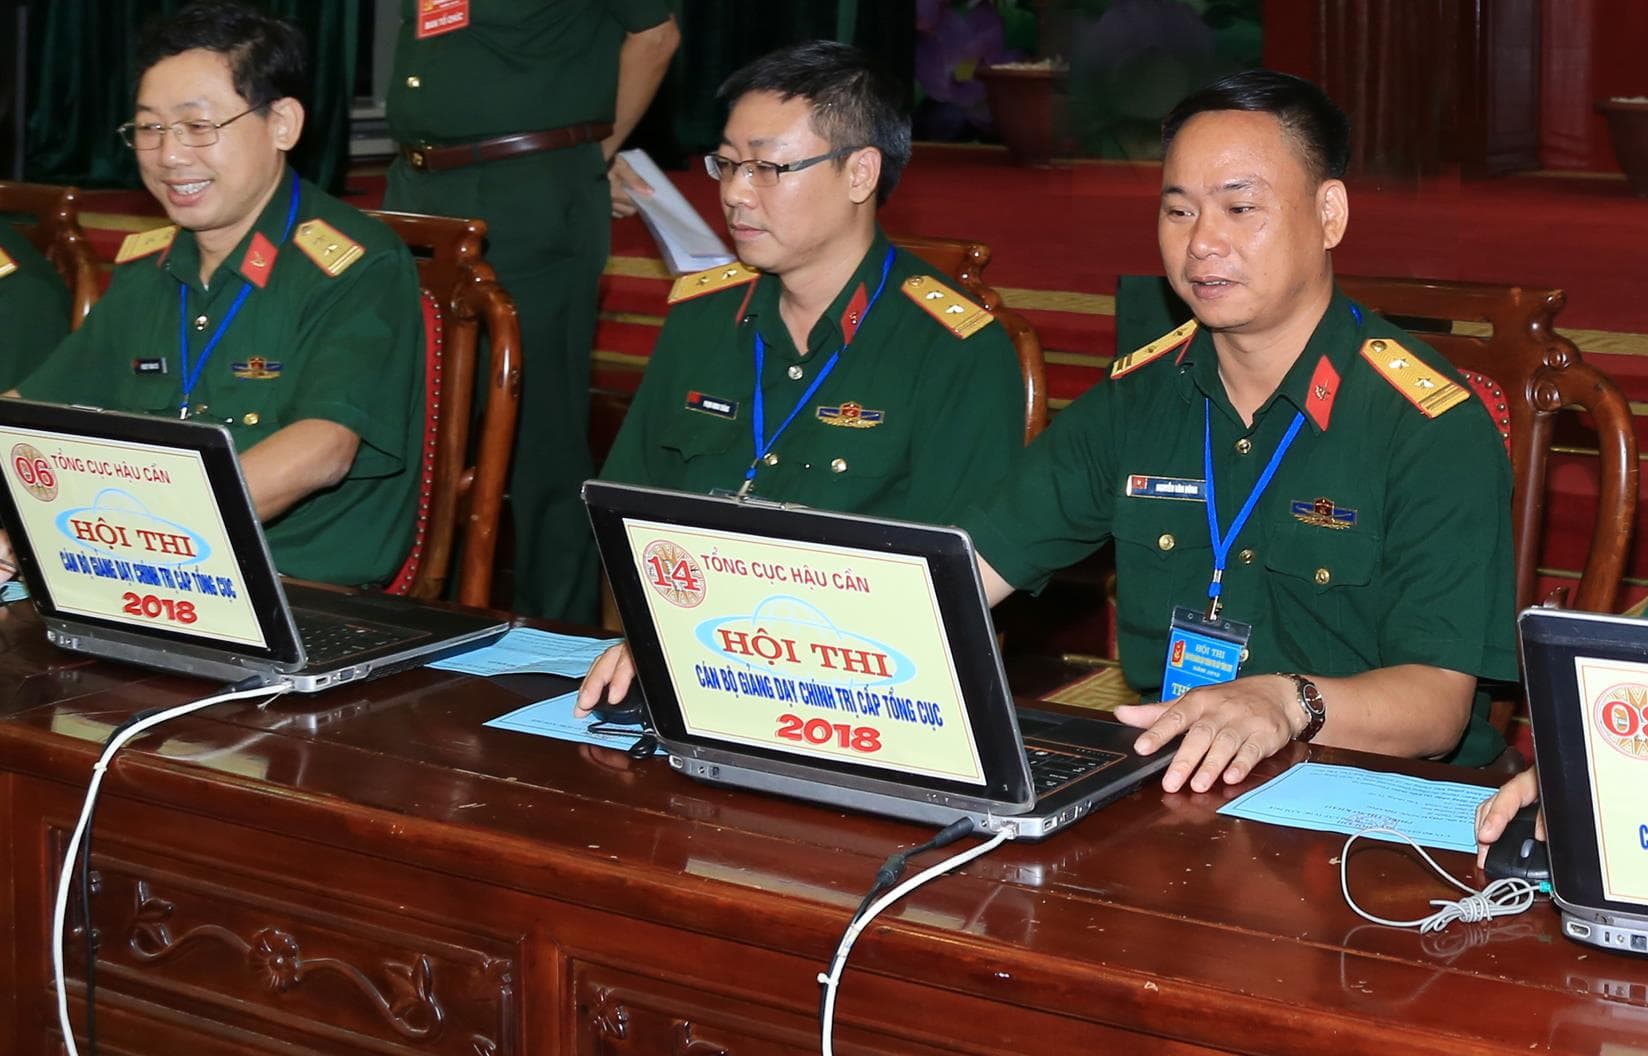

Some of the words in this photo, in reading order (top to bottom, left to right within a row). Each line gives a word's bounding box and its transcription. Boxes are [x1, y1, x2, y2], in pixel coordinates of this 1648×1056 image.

[15, 456, 54, 487] 06
[70, 517, 131, 550] HỘI
[136, 529, 197, 557] THI
[647, 555, 700, 592] 14
[701, 547, 748, 576] TỔNG
[752, 562, 787, 585] CỤC
[791, 564, 828, 590] HẬU
[832, 567, 870, 593] CẦN
[122, 591, 198, 624] 2018
[717, 628, 801, 665] HỘI
[811, 643, 893, 677] THI
[695, 661, 721, 690] CÁN
[720, 665, 739, 698] BỘ
[738, 663, 775, 699] GIẢNG
[773, 677, 798, 708] DẠY
[799, 678, 837, 709] CHÍNH
[835, 687, 859, 718] TRỊ
[857, 684, 880, 716] CẤP
[882, 686, 917, 722] TỔNG
[916, 701, 943, 731] CỤC
[776, 714, 882, 752] 2018
